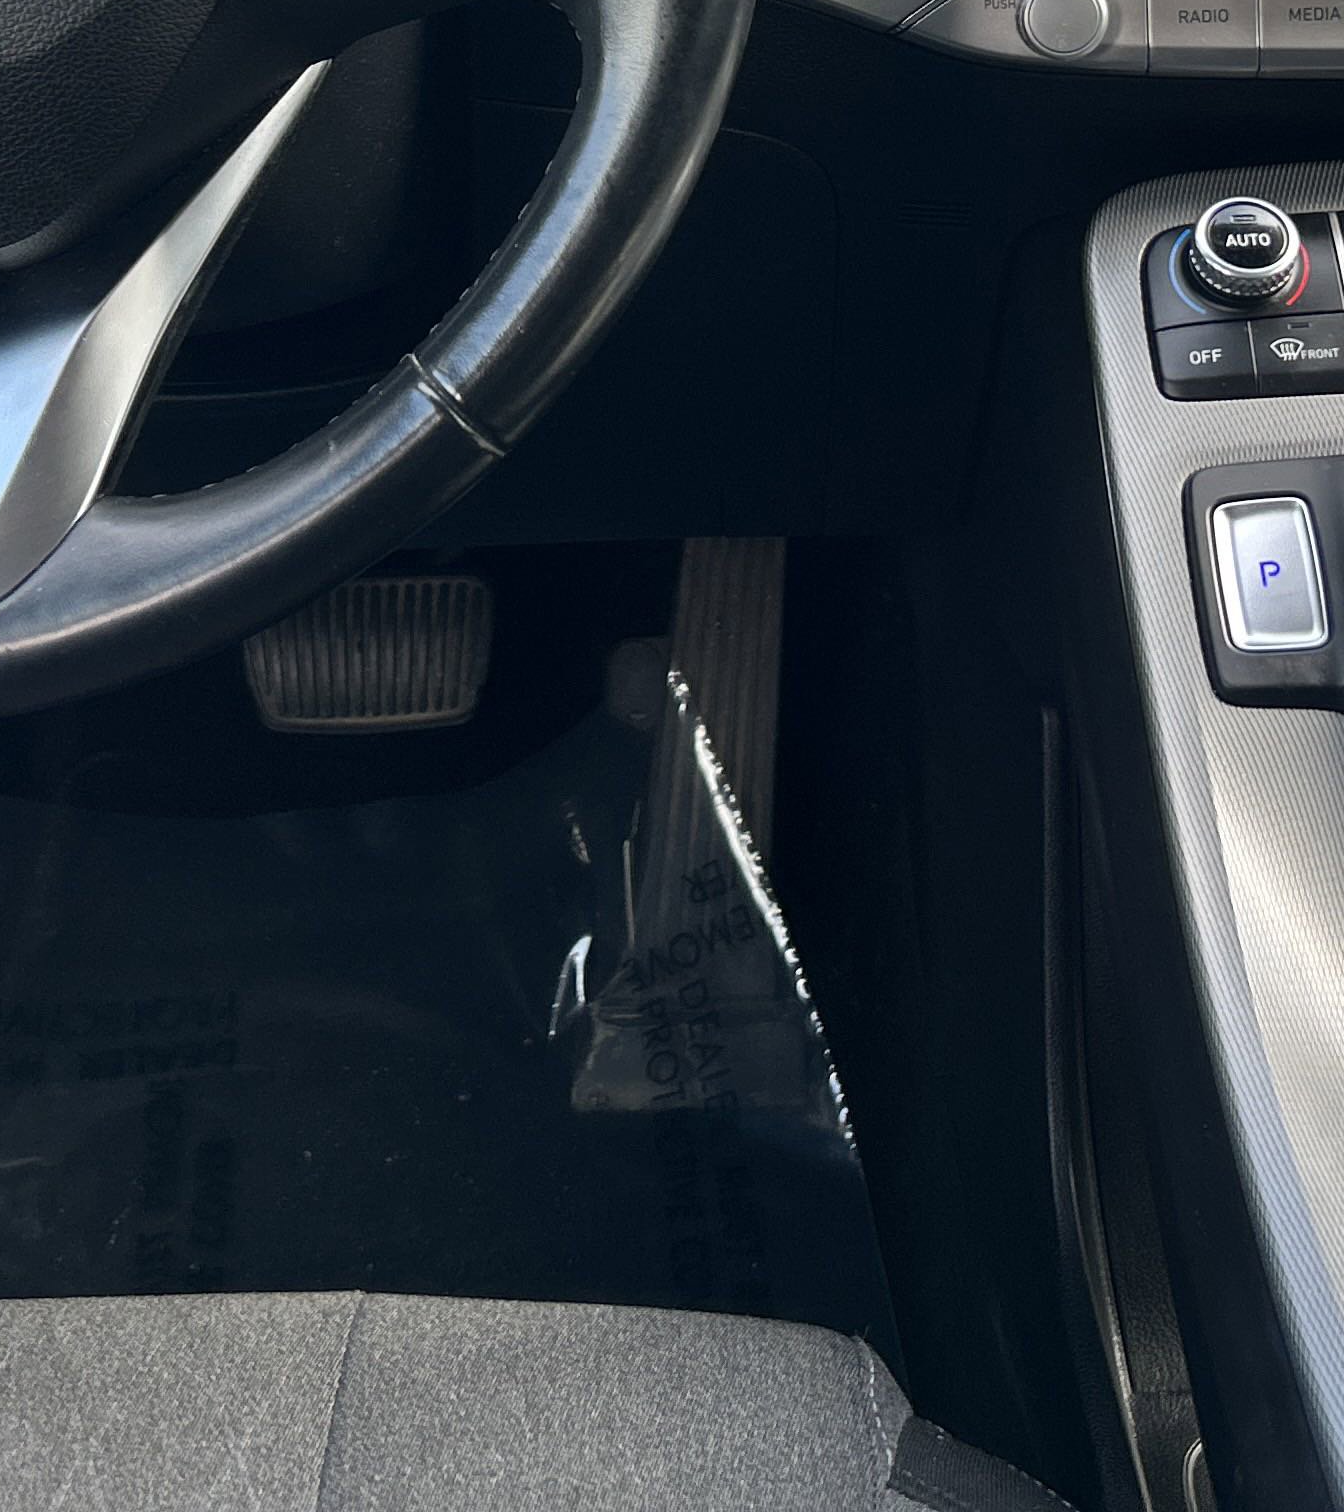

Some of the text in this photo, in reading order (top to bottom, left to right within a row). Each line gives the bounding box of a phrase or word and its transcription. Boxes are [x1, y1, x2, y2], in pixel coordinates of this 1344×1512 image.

[983, 0, 1017, 10] PUSH
[1178, 9, 1229, 24] RADIO
[1288, 6, 1342, 22] MEDIA
[1225, 231, 1272, 250] AUTO
[1189, 348, 1222, 365] OFF
[1300, 347, 1339, 362] FRONT
[1259, 560, 1281, 587] P
